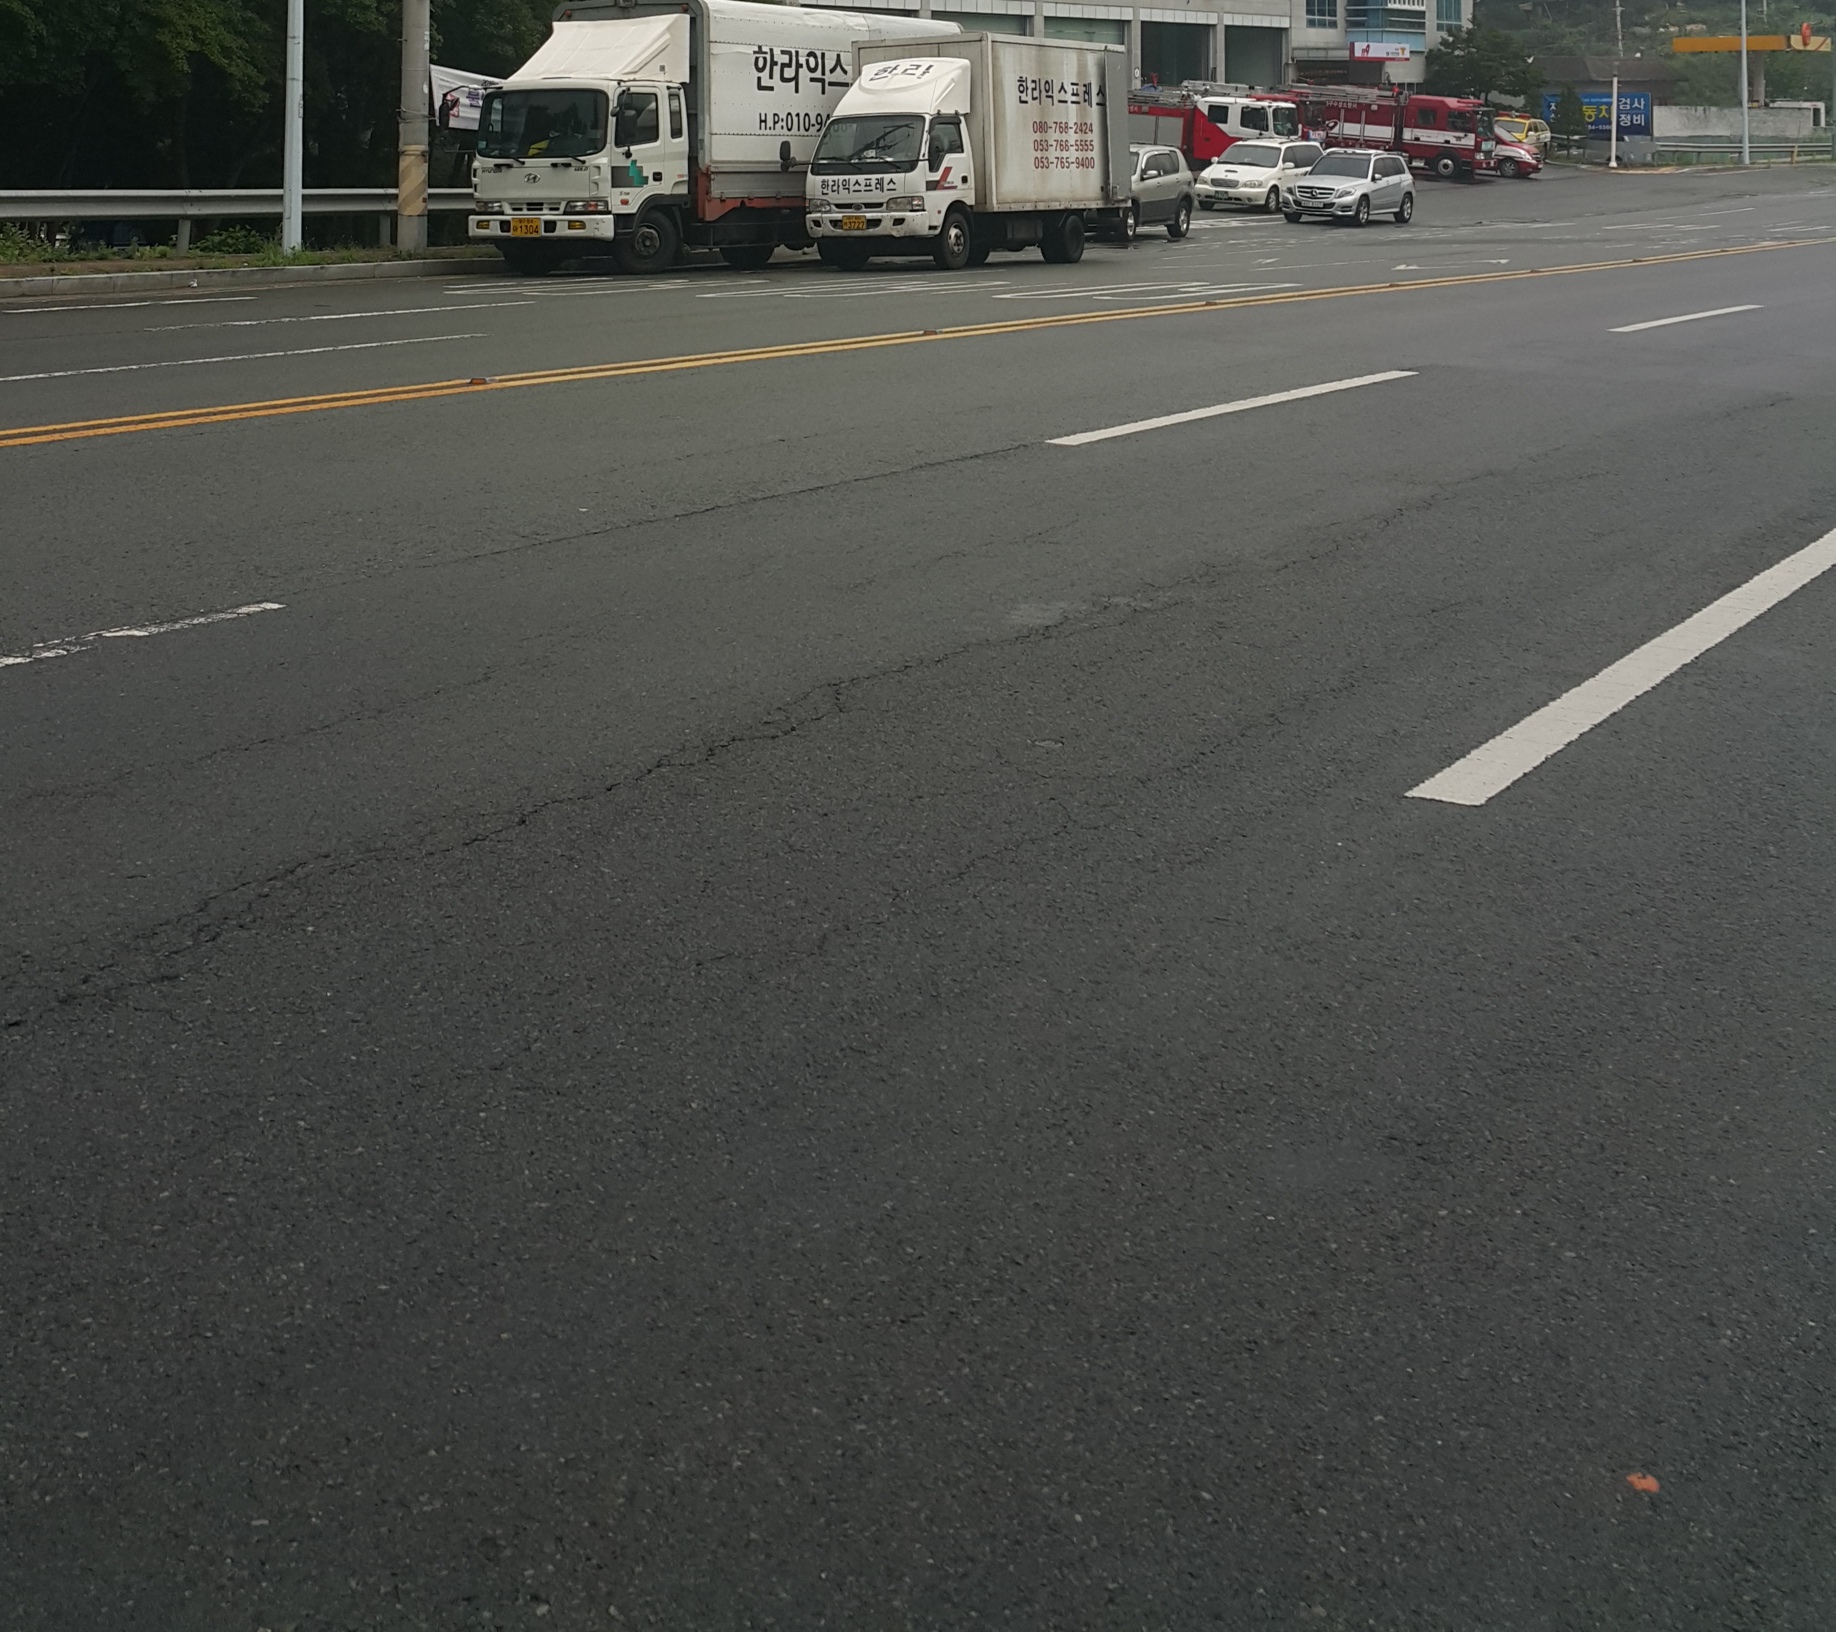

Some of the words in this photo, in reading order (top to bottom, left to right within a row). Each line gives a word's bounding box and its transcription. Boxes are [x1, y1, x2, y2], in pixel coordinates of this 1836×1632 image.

[753, 45, 852, 95] 한라익스
[1017, 75, 1106, 108] 한라익스프레스
[1618, 97, 1645, 110] 검사
[1032, 120, 1094, 135] 080-768-2424
[1618, 114, 1645, 127] 정비
[1033, 139, 1094, 152] 053-768-5555
[1034, 156, 1095, 170] 053-765-9400
[820, 177, 897, 195] 한라익스프레스
